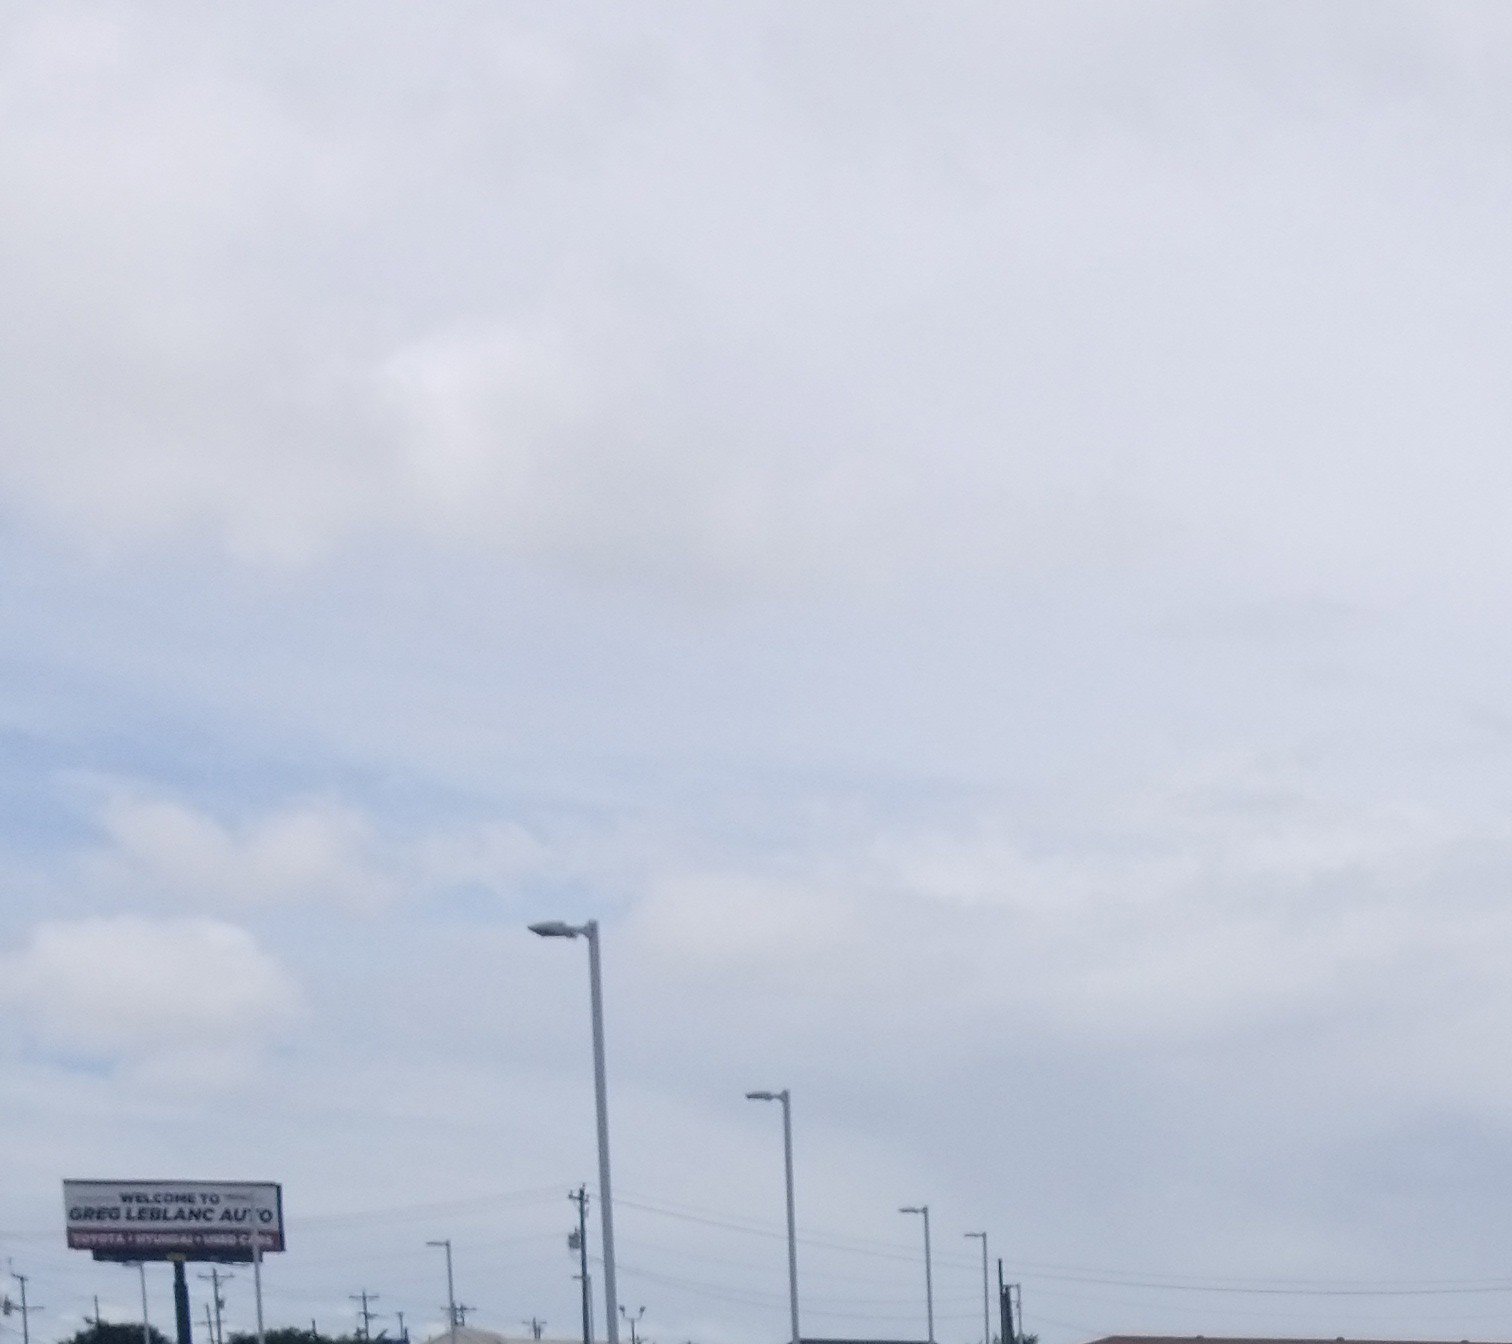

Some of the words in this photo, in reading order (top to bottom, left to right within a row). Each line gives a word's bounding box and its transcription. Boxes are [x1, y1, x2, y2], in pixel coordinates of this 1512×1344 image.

[120, 1192, 196, 1204] WELCOME
[200, 1193, 221, 1205] TO
[69, 1206, 121, 1221] GREG
[125, 1207, 216, 1222] LEBLANC
